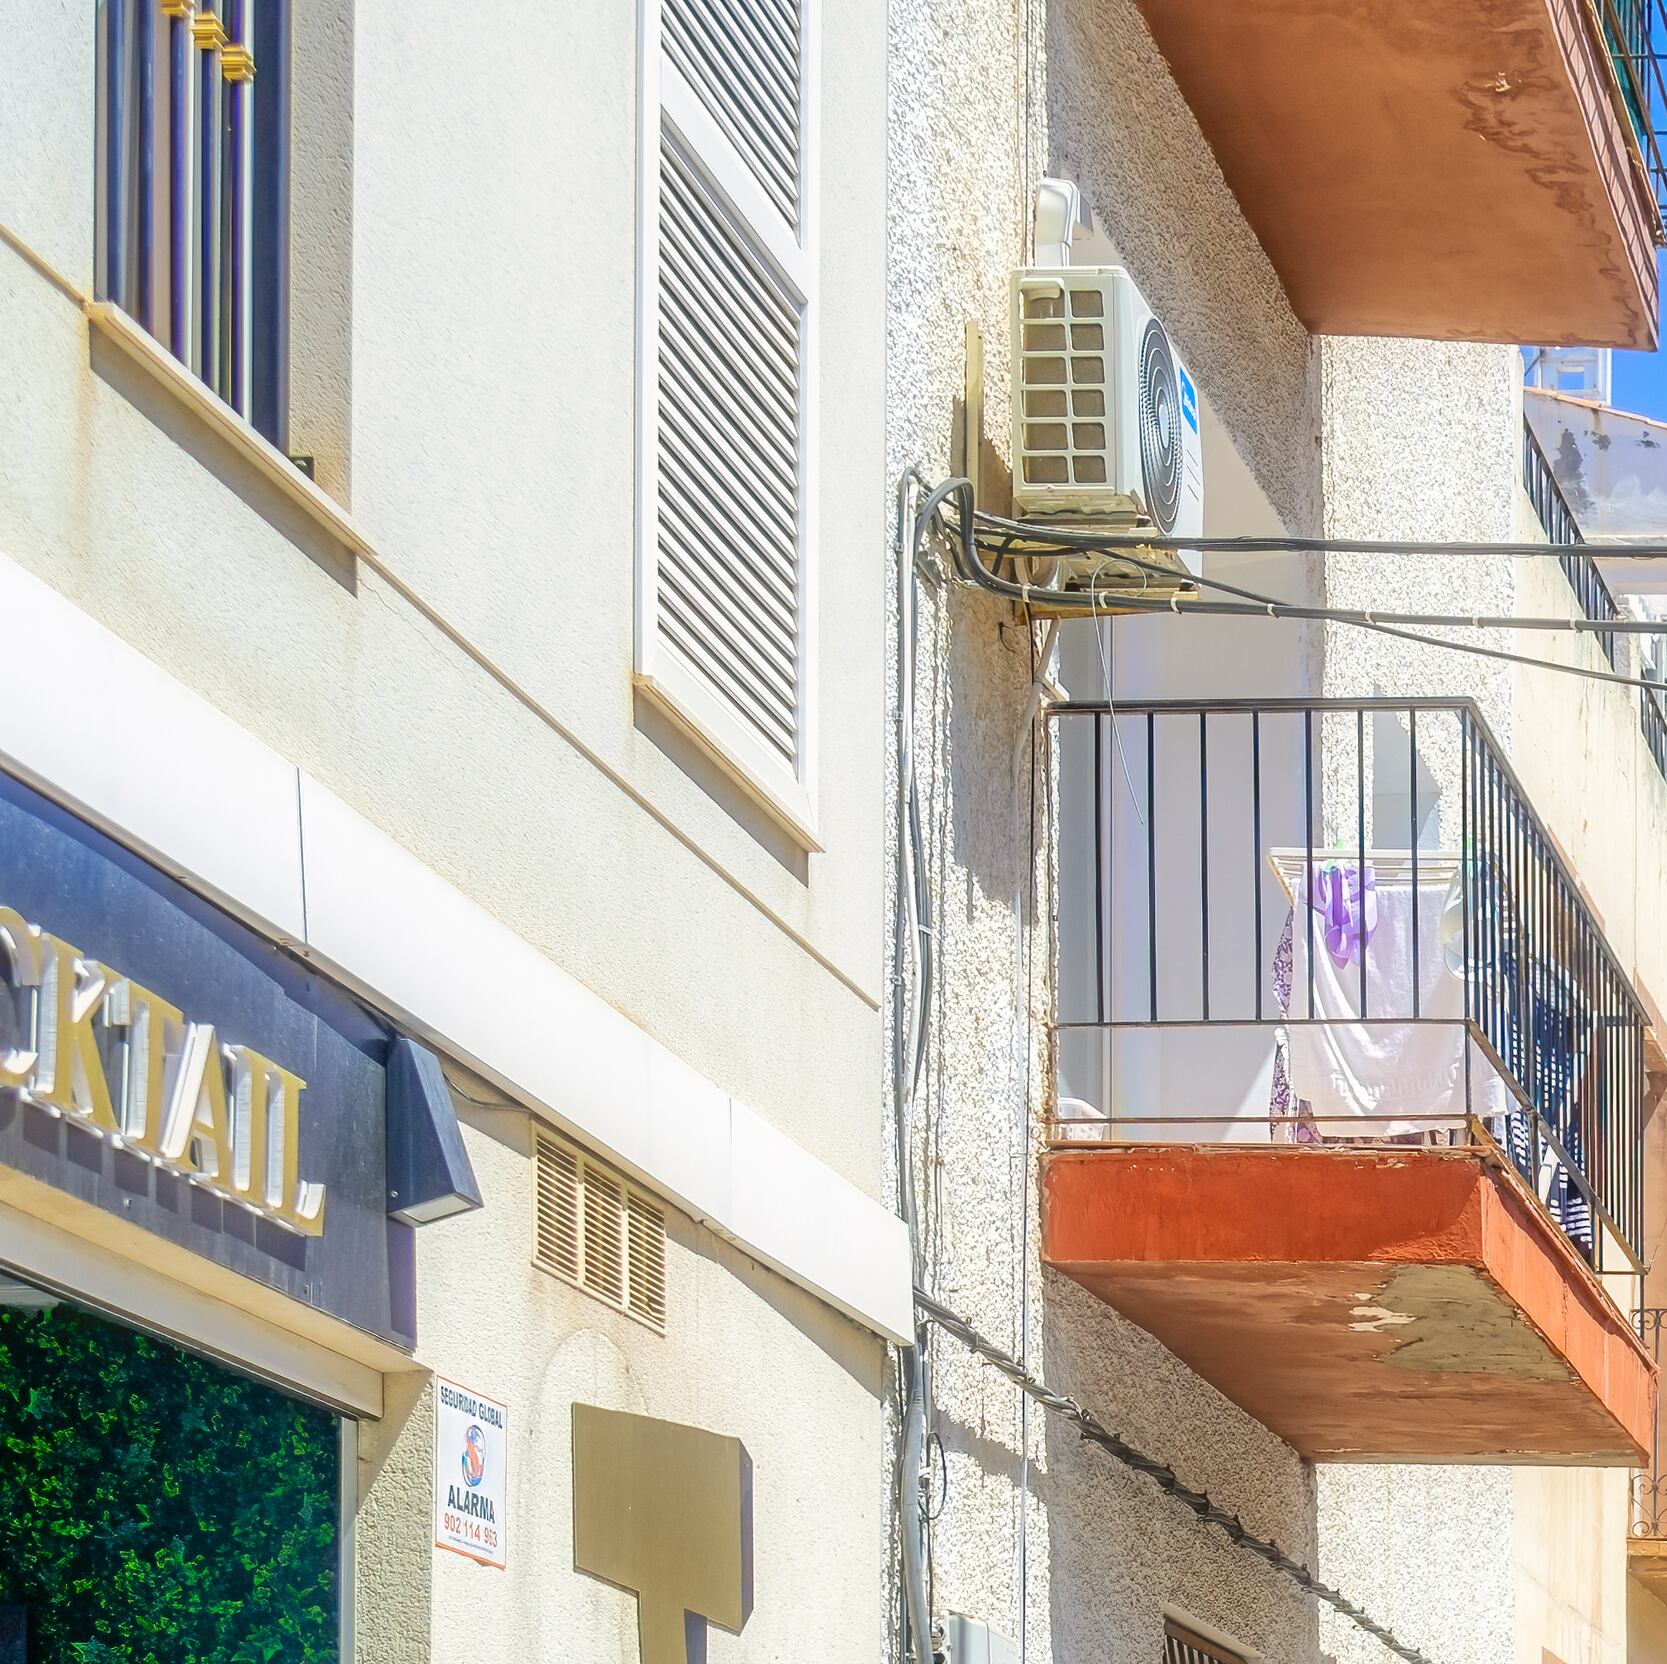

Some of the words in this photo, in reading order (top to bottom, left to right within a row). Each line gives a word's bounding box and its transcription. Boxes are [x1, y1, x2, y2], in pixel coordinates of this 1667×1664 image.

[440, 1385, 477, 1418] SEGURIDAD
[478, 1402, 504, 1429] GLOBAL
[447, 1484, 496, 1524] ALARMA
[444, 1512, 461, 1535] 902
[464, 1521, 481, 1543] 114
[484, 1526, 498, 1548] 963
